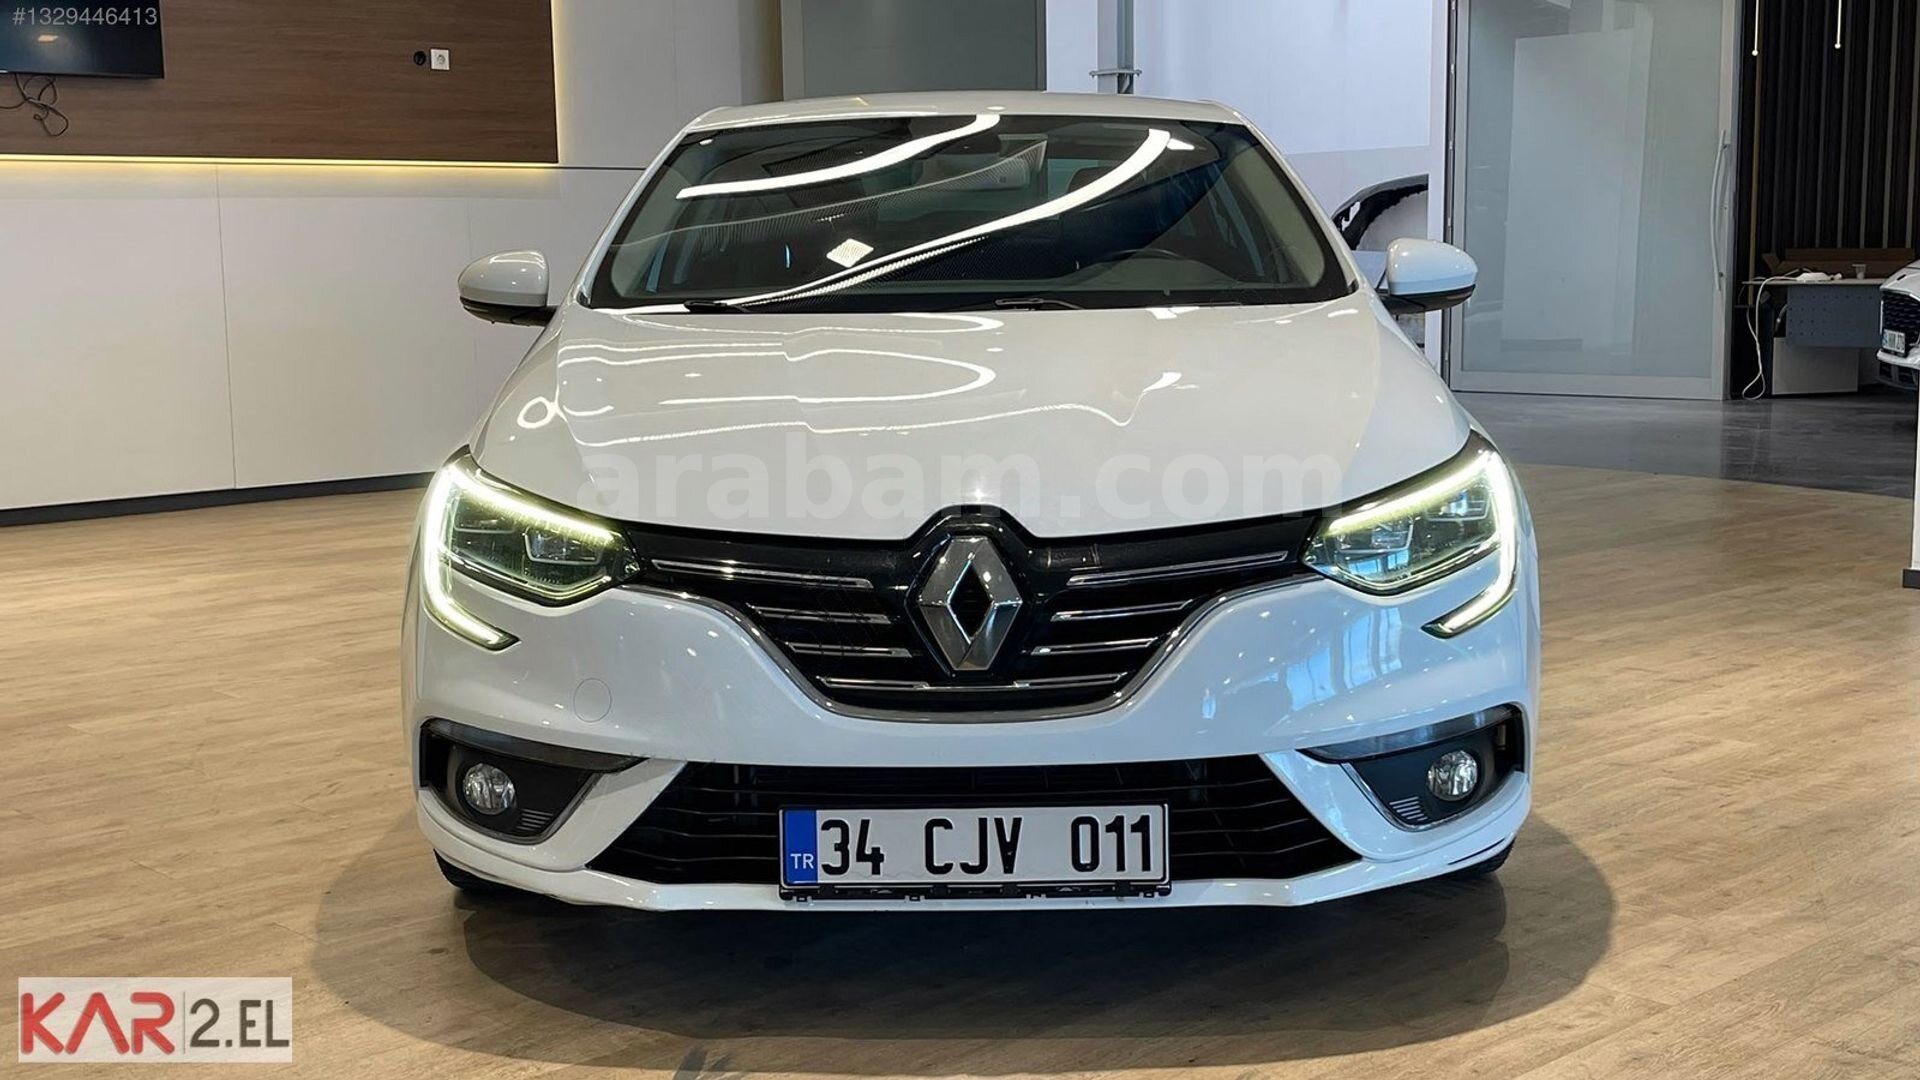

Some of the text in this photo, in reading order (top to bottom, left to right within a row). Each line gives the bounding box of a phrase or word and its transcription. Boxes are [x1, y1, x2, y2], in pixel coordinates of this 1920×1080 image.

[790, 814, 1152, 876] TR 34 CJV 011
